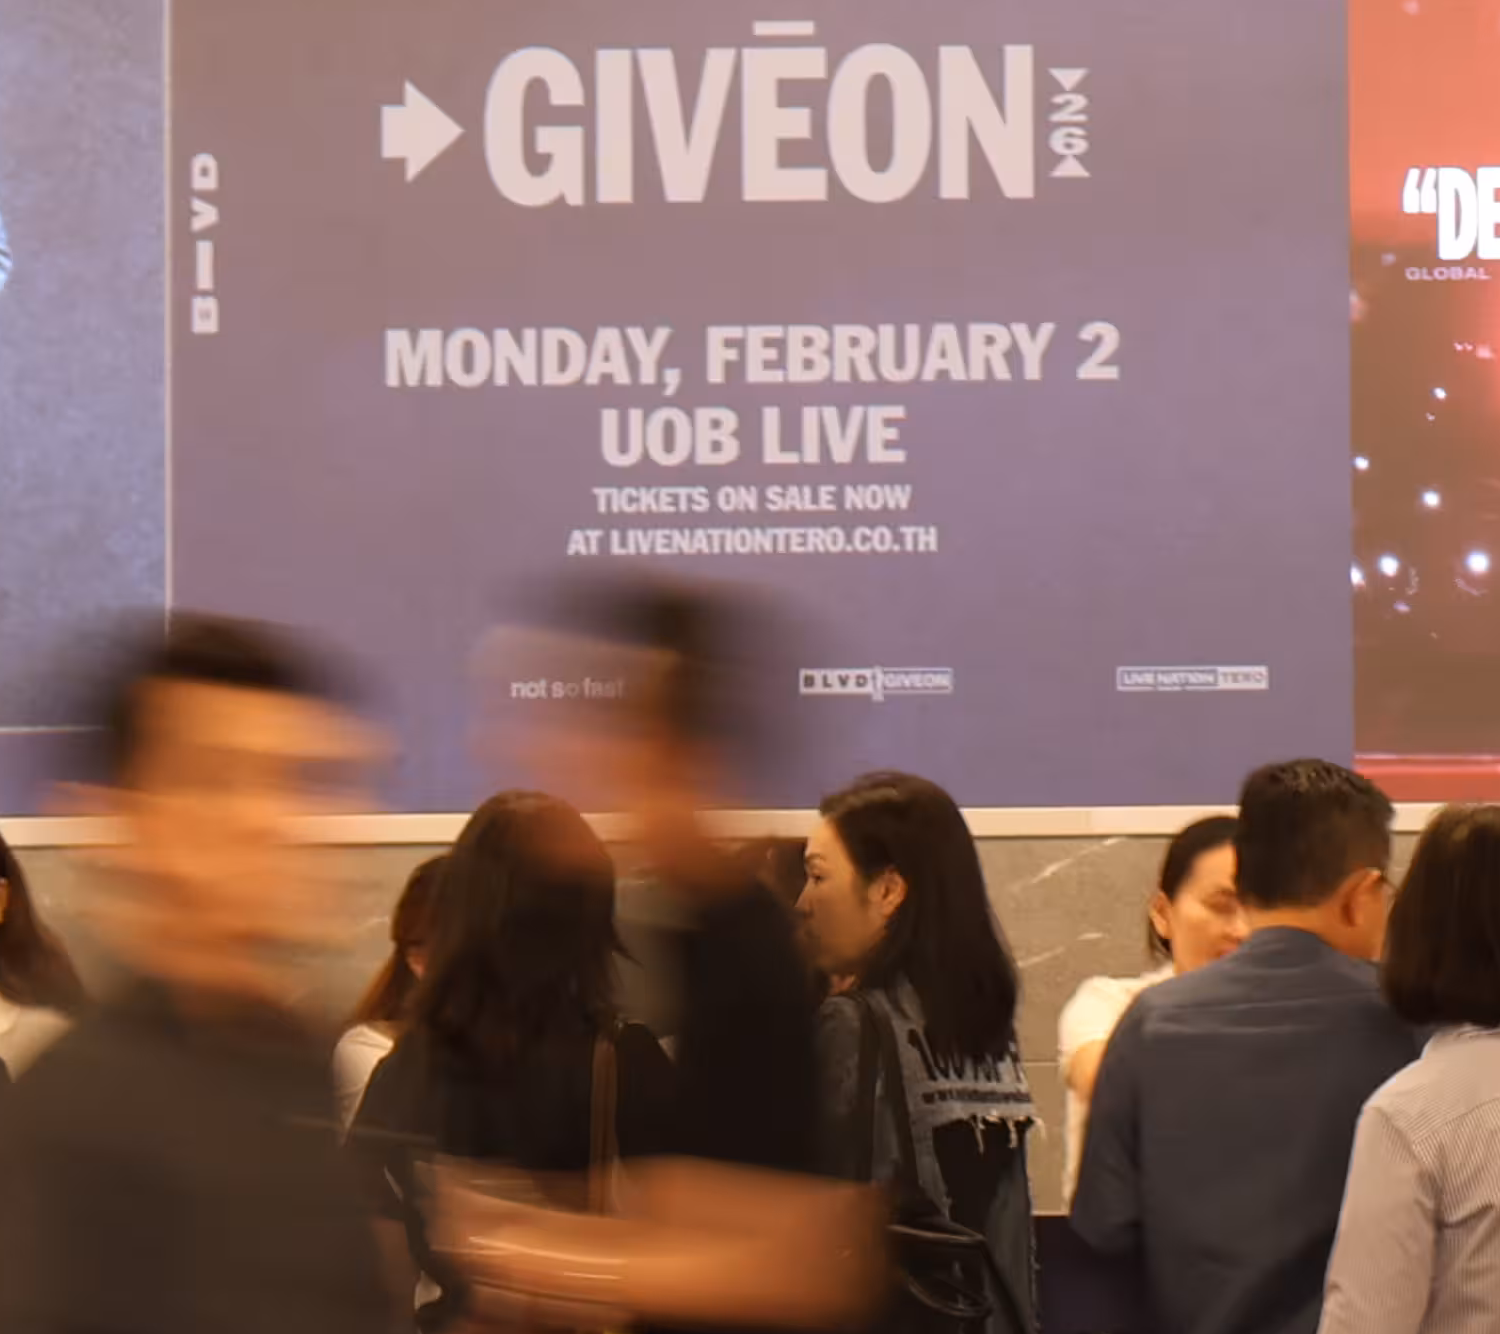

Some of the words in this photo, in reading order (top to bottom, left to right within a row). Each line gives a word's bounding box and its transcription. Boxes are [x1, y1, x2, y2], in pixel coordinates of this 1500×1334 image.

[484, 20, 1033, 206] GIVĒON
[1405, 267, 1491, 281] GLOBAL
[385, 327, 681, 396] MONDAY,
[706, 323, 1056, 383] FEBRUARY
[1077, 322, 1120, 380] 2
[602, 408, 739, 467] UOB
[762, 405, 907, 463] LIVE
[593, 487, 709, 513] TICKETS
[717, 487, 758, 511] ON
[765, 486, 837, 511] SALE
[844, 485, 911, 510] NOW
[568, 529, 601, 555] AT
[610, 526, 937, 554] LIVENATIONTERO.CO.TH
[510, 678, 548, 699] not
[551, 680, 579, 699] so
[803, 673, 868, 688] BLVD
